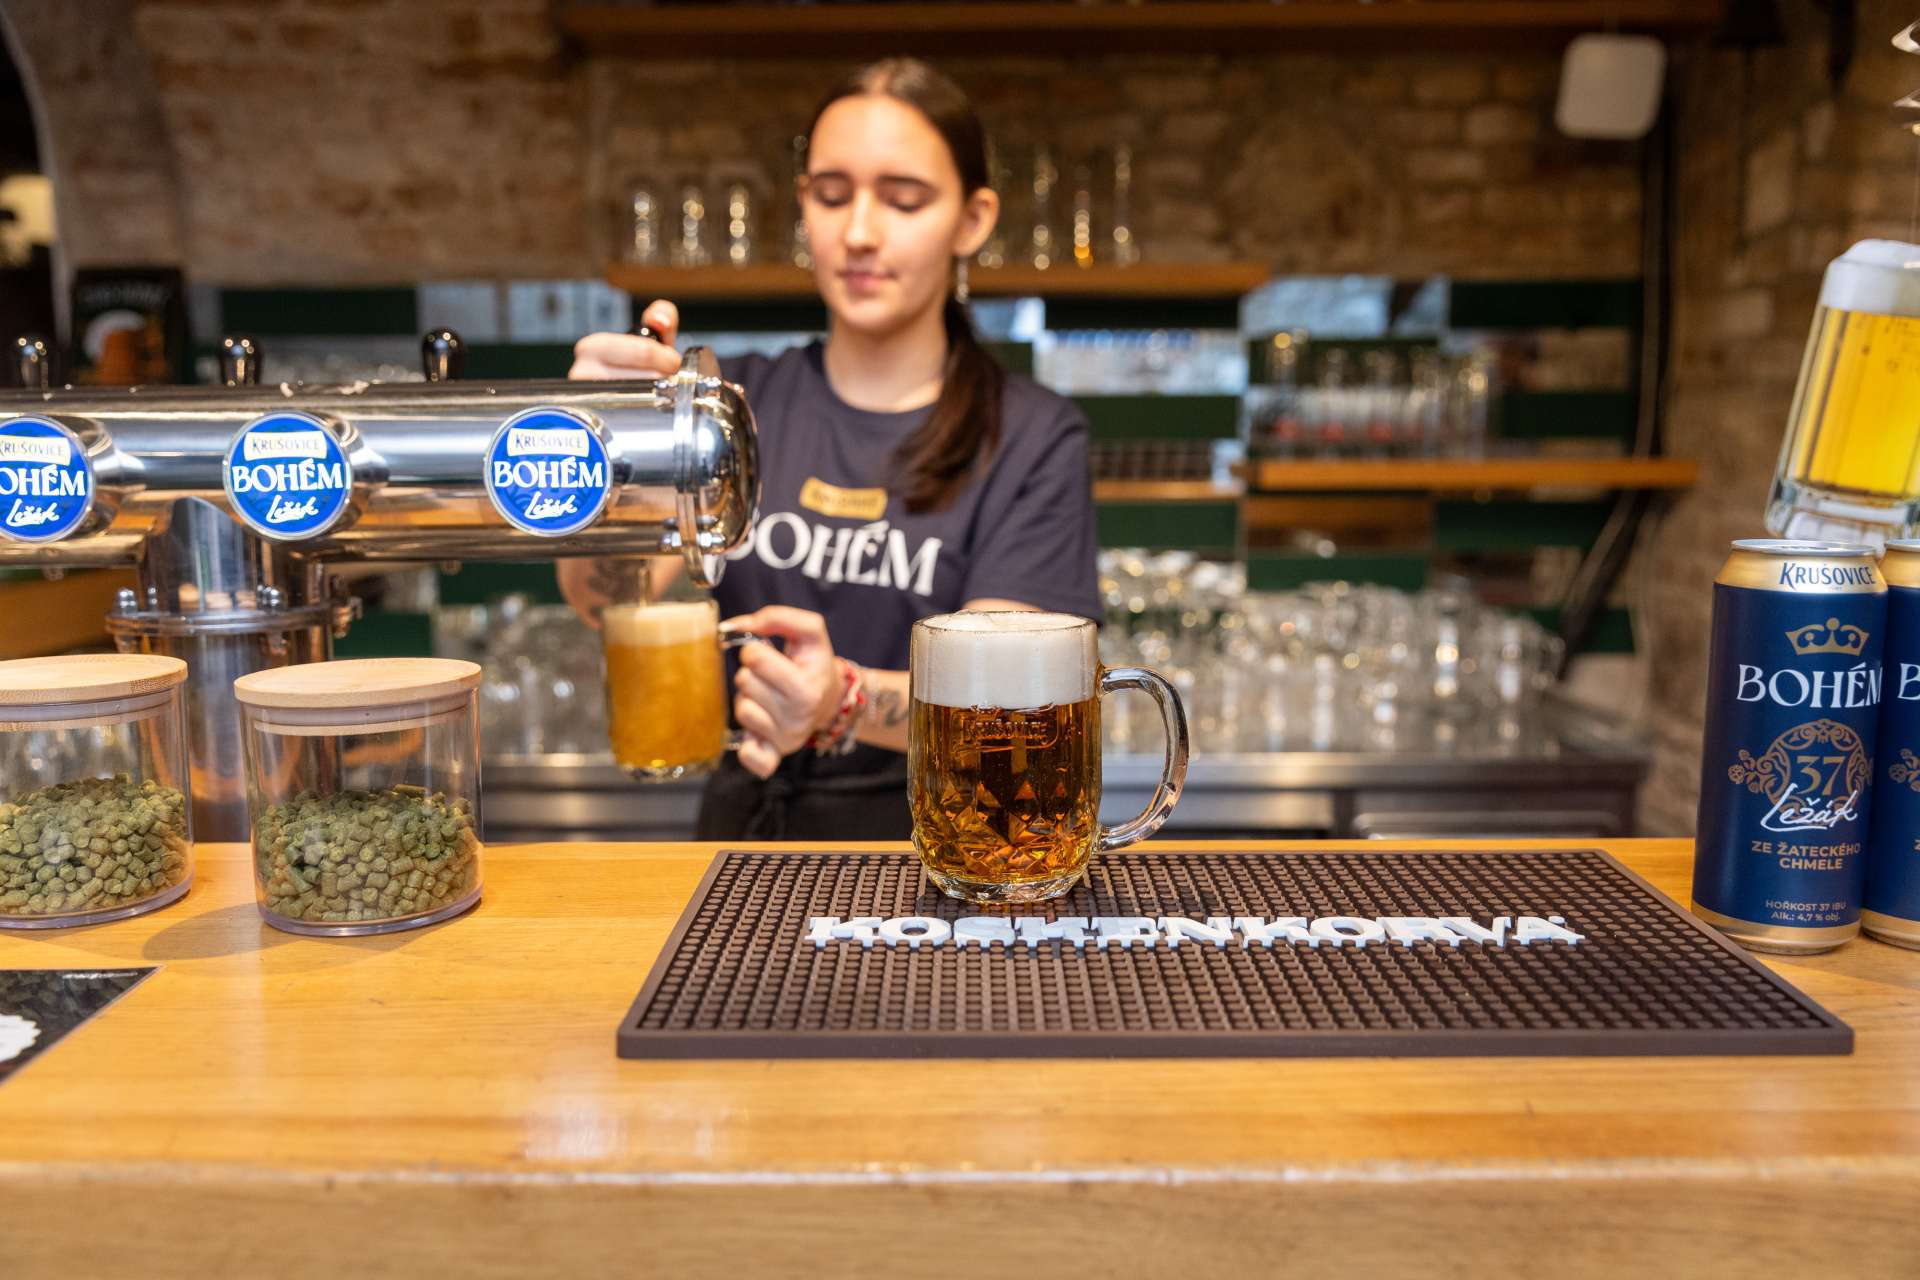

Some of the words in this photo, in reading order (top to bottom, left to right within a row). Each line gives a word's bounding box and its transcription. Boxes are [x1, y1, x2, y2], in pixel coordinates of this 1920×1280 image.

[0, 464, 86, 496] OHÉM
[231, 458, 343, 493] BOHÉM
[493, 456, 604, 488] BOHÉM
[1778, 562, 1876, 590] KRUŠOVICE
[1736, 662, 1883, 709] BOHÉM
[1796, 755, 1846, 796] 37
[1760, 783, 1858, 832] Ležák
[1751, 840, 1772, 853] ZE
[1777, 841, 1861, 857] ŽATECKÉHO
[1779, 857, 1843, 870] CHMELE
[1765, 900, 1818, 911] HOŘKOST
[1819, 903, 1830, 911] 37
[804, 916, 1586, 948] KOSKENKORVA
